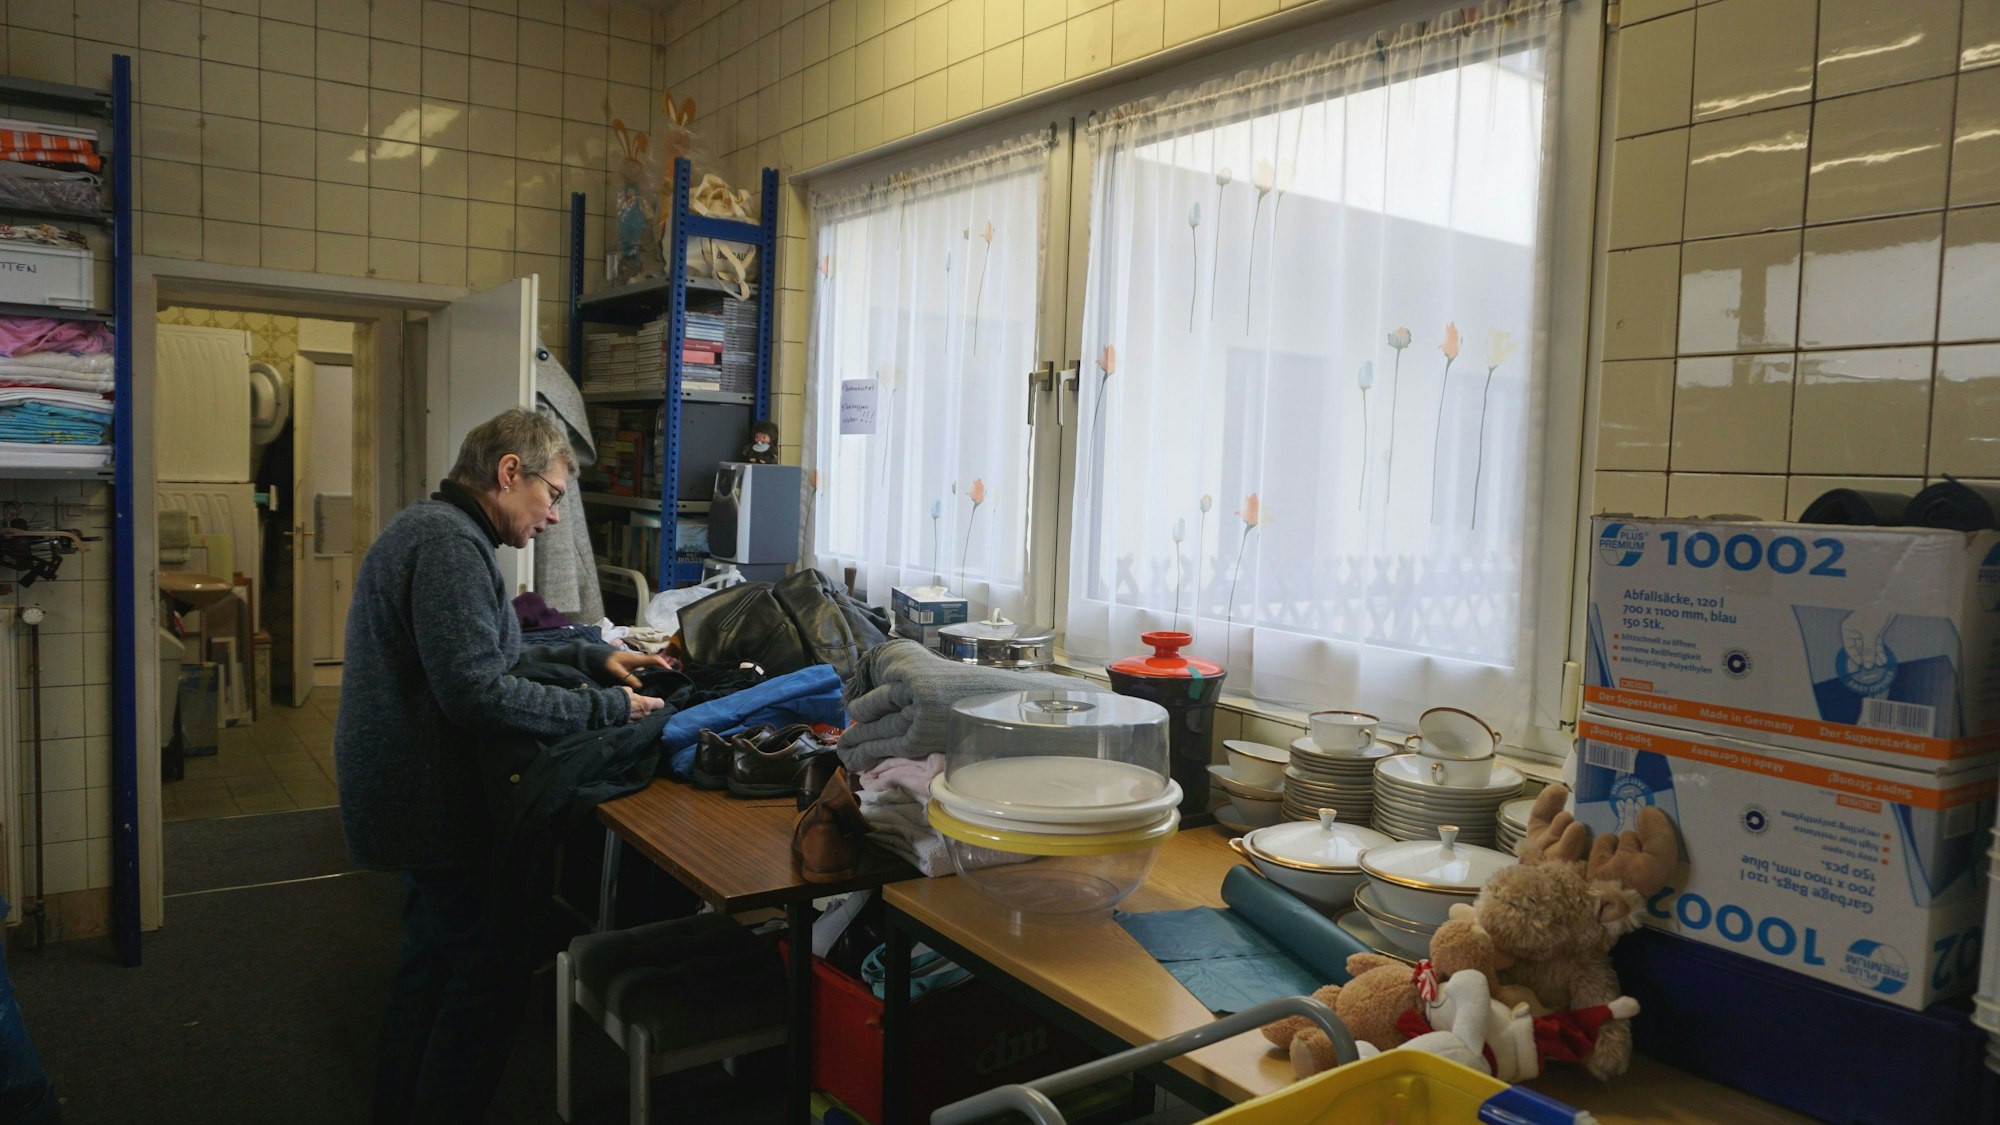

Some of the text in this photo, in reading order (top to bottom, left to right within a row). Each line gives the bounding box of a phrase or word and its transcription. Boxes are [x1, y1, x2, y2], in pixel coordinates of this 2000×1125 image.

[1599, 539, 1645, 551] PREMIUM
[1620, 530, 1644, 541] PLUS
[1660, 530, 1847, 578] 10002
[1624, 589, 1694, 607] Abfallsäcke,
[1697, 597, 1717, 608] 120
[1622, 617, 1665, 630] 150 Stk.
[1623, 604, 1738, 624] 700 x 1100 mm, blau
[1621, 644, 1649, 655] extreme
[1598, 691, 1615, 703] Der
[1699, 708, 1795, 733] Made in Germany
[1589, 726, 1624, 742] Strong!
[1624, 734, 1653, 747] Super
[1819, 727, 1841, 740] Der
[1691, 745, 1784, 773] Made in Germany
[1826, 772, 1913, 800] Super Strong!
[1741, 855, 1875, 897] 700 x 1100 mm, blue
[1747, 871, 1769, 884] 120
[1820, 860, 1876, 882] 150 pcs.
[1773, 876, 1809, 897] Bags,
[1812, 887, 1874, 915] Garbage
[1646, 885, 1826, 967] 10002
[1845, 952, 1909, 980] PREMIUM
[1846, 963, 1878, 984] PLUS
[976, 1025, 1049, 1073] dm
